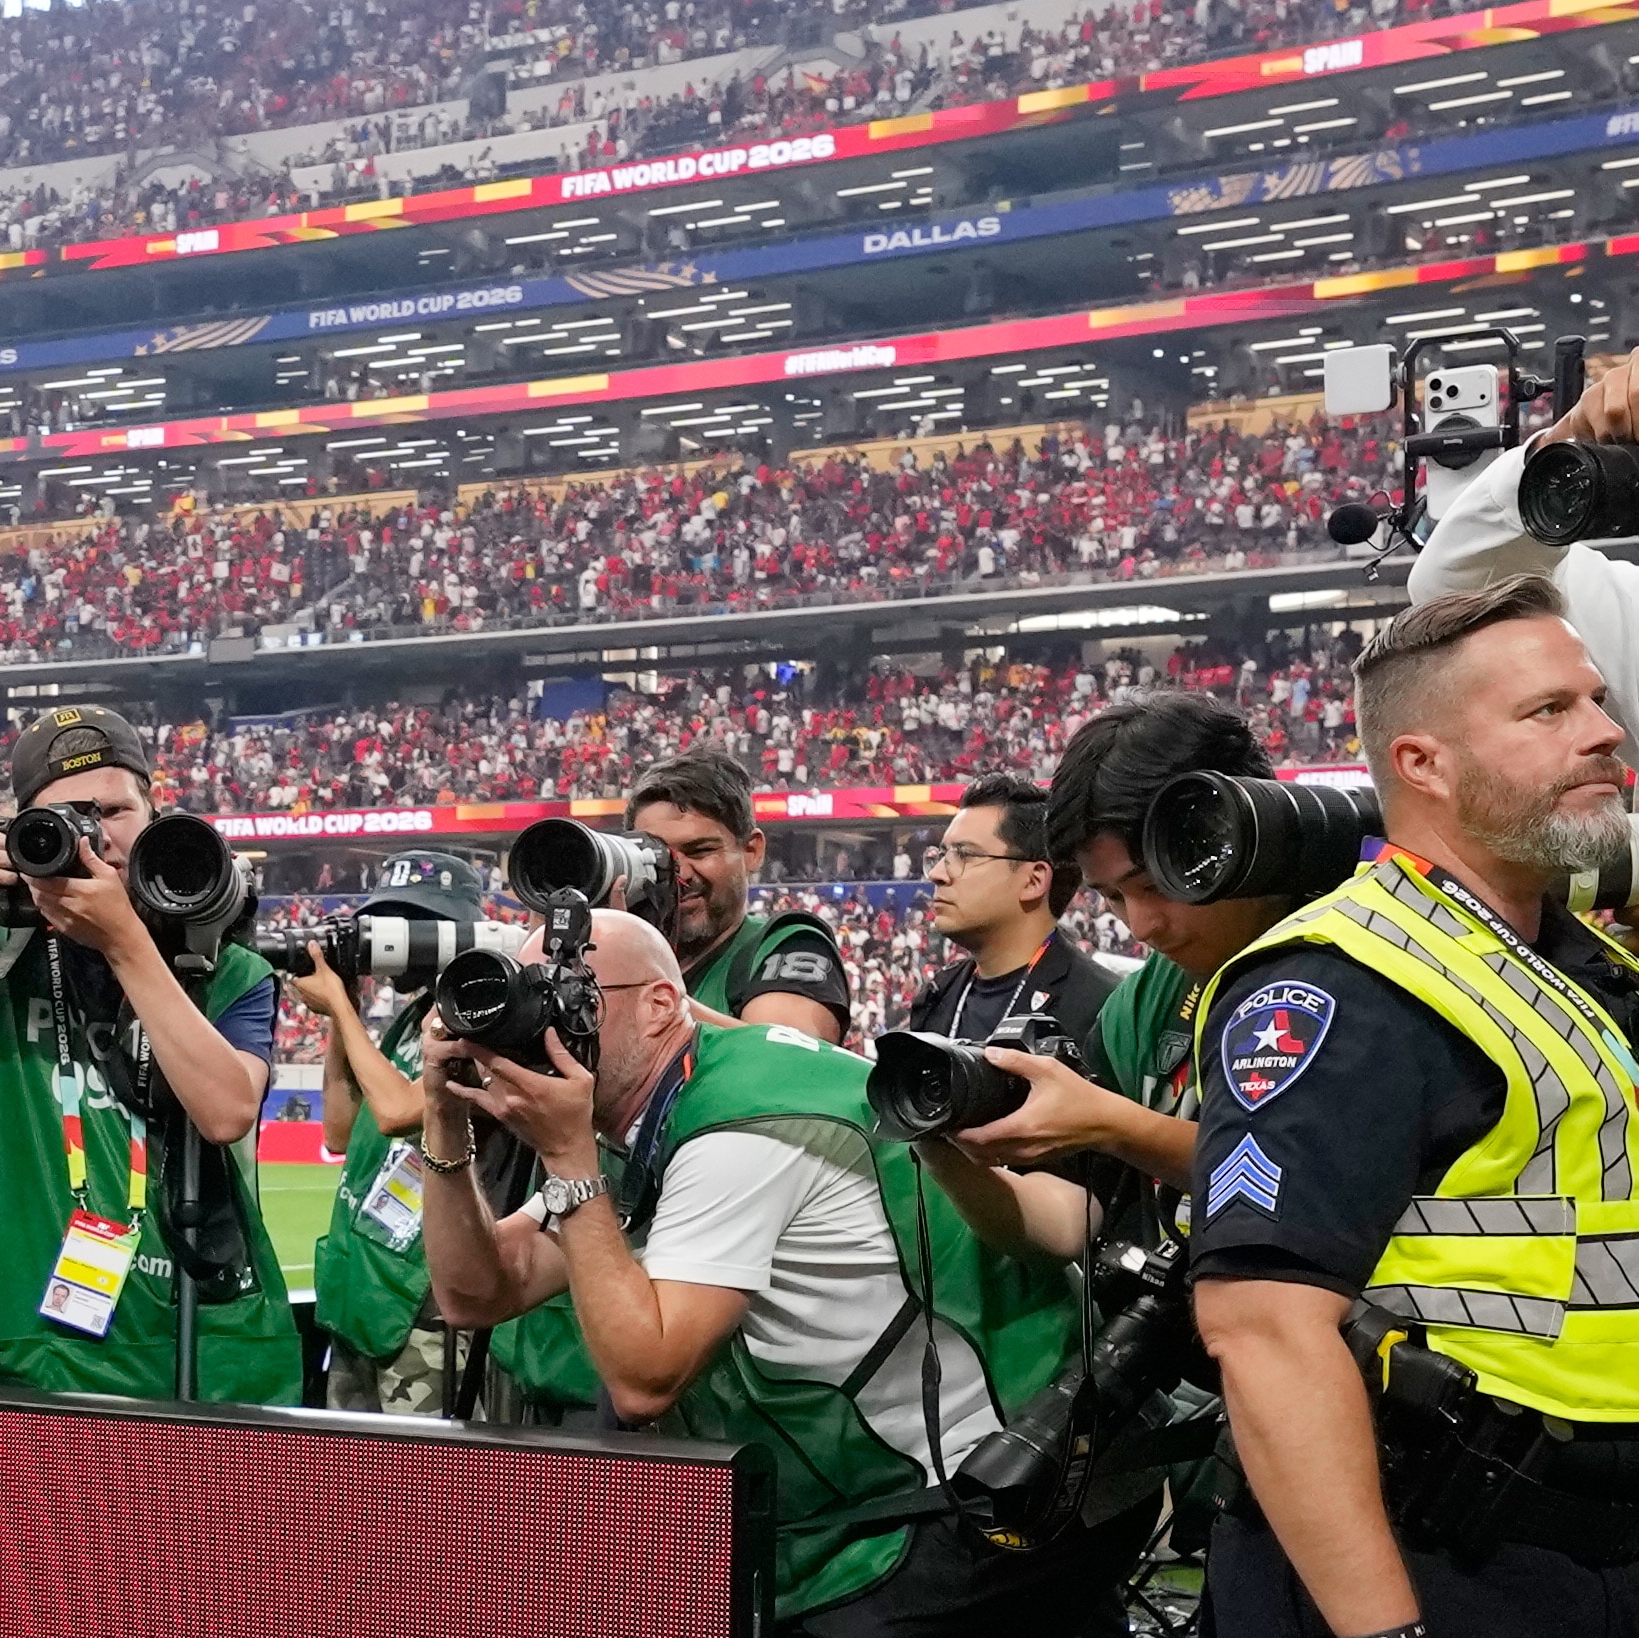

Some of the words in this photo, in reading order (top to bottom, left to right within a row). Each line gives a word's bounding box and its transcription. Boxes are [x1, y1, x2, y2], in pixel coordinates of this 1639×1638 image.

[1303, 39, 1362, 74] SPAIN
[561, 168, 612, 199] FIFA
[613, 157, 697, 192] WORLD
[697, 149, 748, 176] CUP
[748, 133, 836, 169] 2026
[863, 217, 1001, 254] DALLAS
[309, 308, 347, 329] FIFA
[349, 299, 410, 325] WORLD
[412, 295, 454, 317] CUP
[456, 285, 522, 311] 2026
[62, 752, 102, 771] BOSTON
[787, 794, 834, 817] SPAIN
[215, 819, 257, 838] FIFA
[258, 815, 321, 836] WORLD
[322, 813, 363, 833] CUP
[364, 810, 433, 832] 2026
[1441, 879, 1493, 923] 2026
[1489, 920, 1518, 948] CUP
[47, 938, 59, 961] FIFA
[48, 961, 63, 999] WORLD
[761, 951, 834, 982] 18
[1516, 945, 1566, 991] WORLD
[54, 1002, 65, 1023] CUP
[1180, 982, 1201, 1020] Nik
[1237, 987, 1325, 1018] POLICE
[1566, 989, 1595, 1018] FIFA
[56, 1024, 71, 1066] 2026
[138, 1063, 148, 1088] FIFA
[1231, 1056, 1298, 1071] ARLINGTON
[1238, 1080, 1276, 1092] TEXAS
[1142, 1272, 1165, 1287] Nikon
